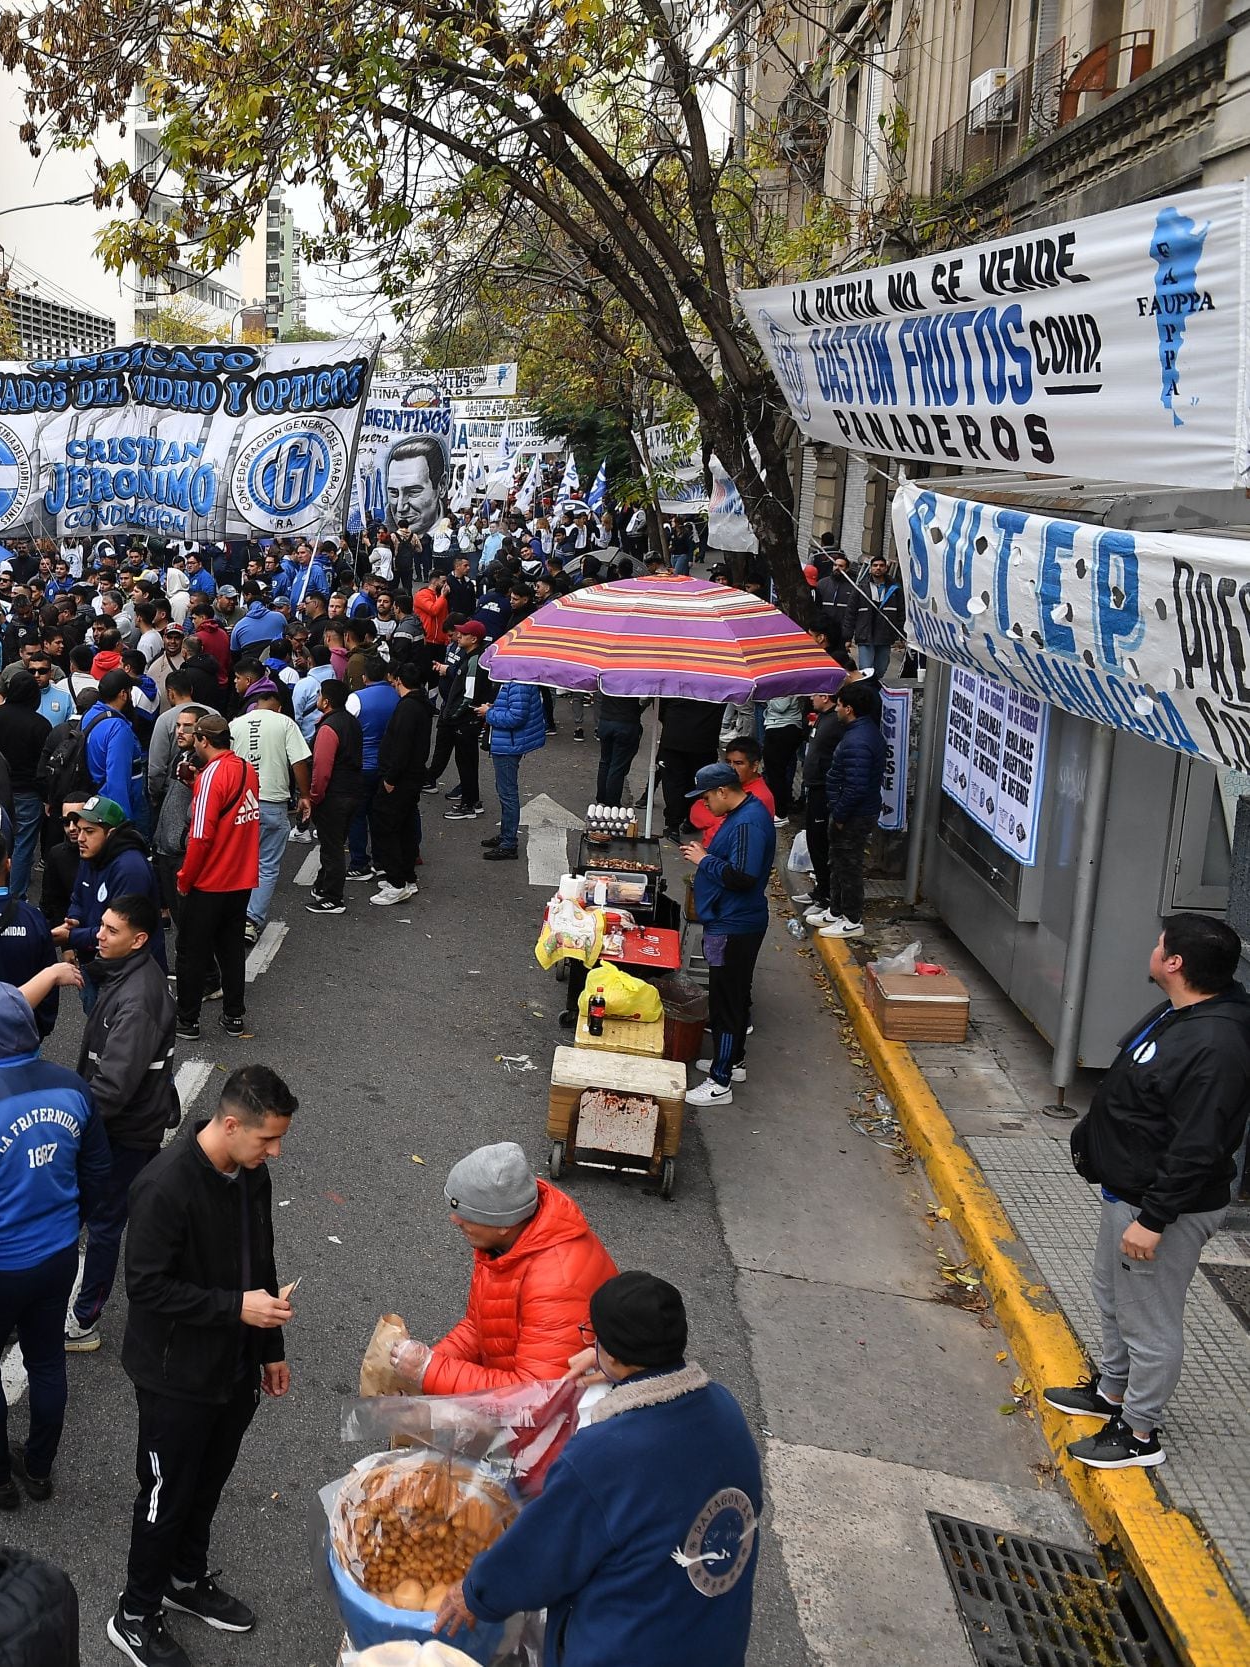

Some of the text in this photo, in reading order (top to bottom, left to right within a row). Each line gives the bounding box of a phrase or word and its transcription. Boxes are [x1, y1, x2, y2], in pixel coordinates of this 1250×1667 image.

[792, 290, 820, 326] LA
[888, 271, 926, 311] NO
[932, 258, 976, 307] SE
[979, 231, 1090, 297] VENDE
[1137, 290, 1216, 317] FAUPPA
[808, 320, 898, 406] GASTON
[899, 303, 1034, 407] FRUTOS
[1029, 313, 1102, 375] COND.
[76, 380, 124, 406] DEL
[133, 375, 216, 411] VIDRIO
[224, 380, 247, 413] Y
[257, 362, 364, 411] OPTICOS
[284, 419, 332, 433] GENERAL
[326, 429, 339, 452] DEL
[833, 410, 1056, 465] PANADEROS
[12, 443, 25, 461] DEL
[19, 460, 30, 491] VIDRIO
[66, 436, 205, 467] CRISTIAN
[236, 427, 282, 512] CONFEDERACION
[44, 463, 216, 516] JERONIMO
[321, 451, 342, 505] TRABAJO
[65, 505, 188, 533] CONDUCCION
[10, 1107, 81, 1138] FRATERNIDAD
